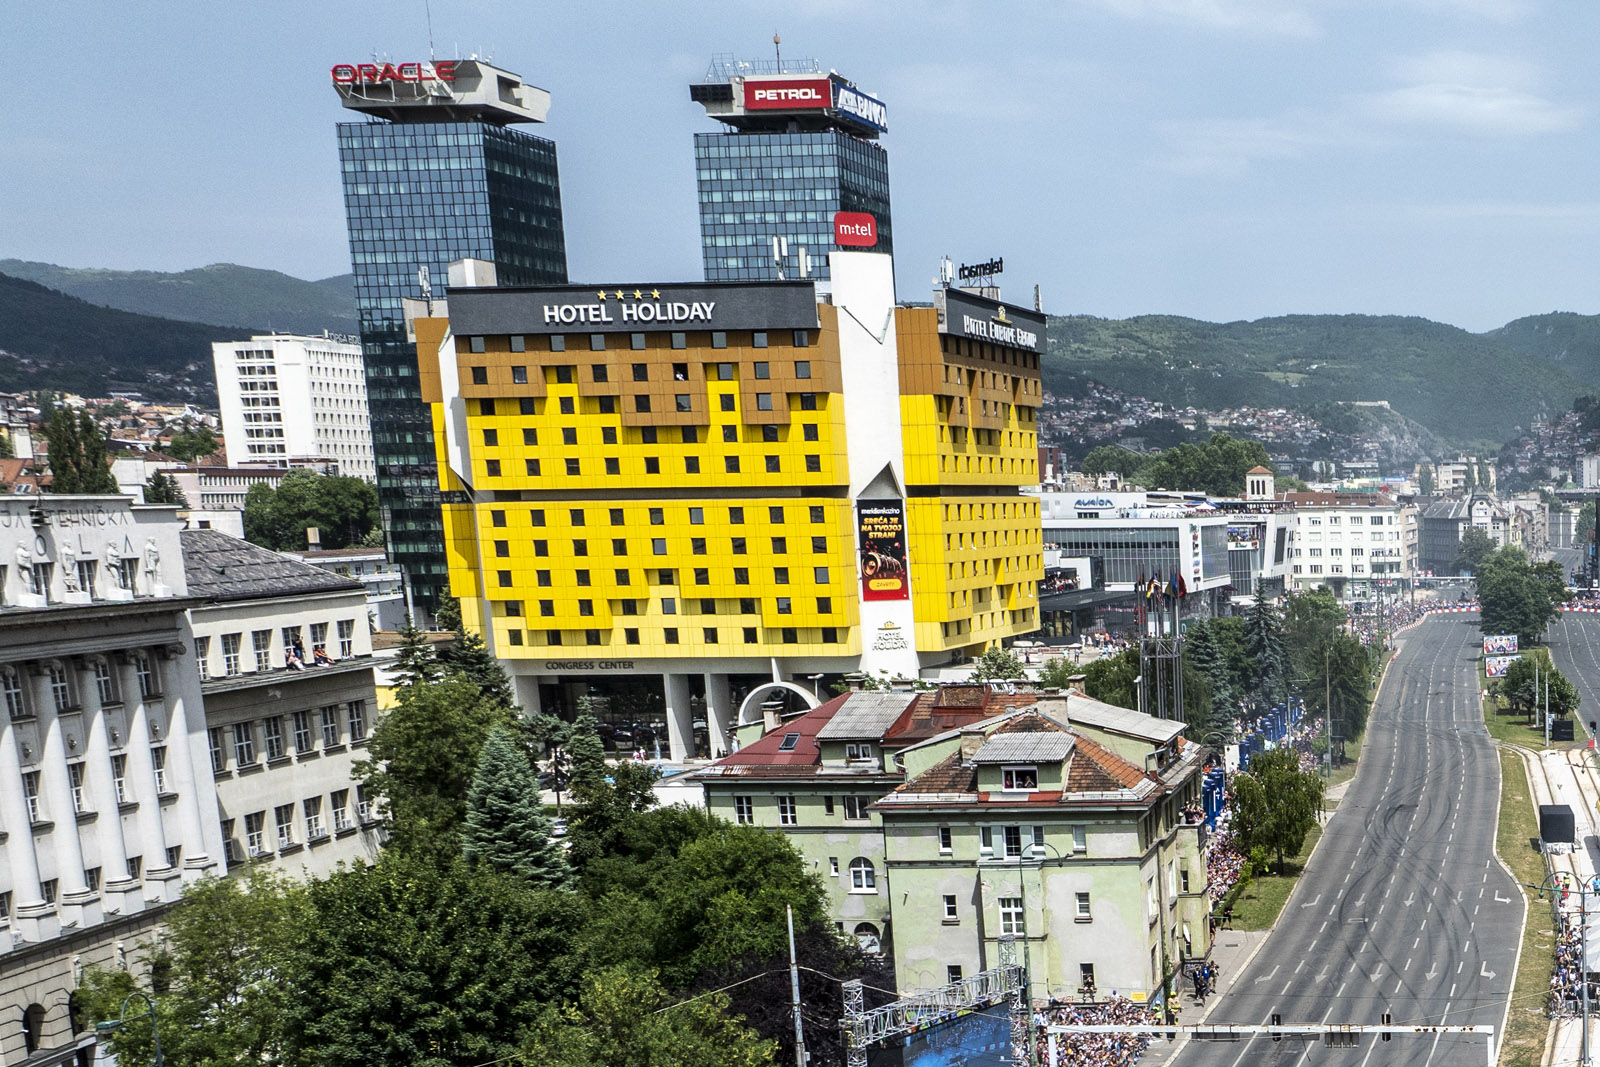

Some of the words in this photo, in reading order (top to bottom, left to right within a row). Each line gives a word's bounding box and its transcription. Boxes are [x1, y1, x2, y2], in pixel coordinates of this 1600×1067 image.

[331, 62, 456, 82] ORACLE
[754, 88, 822, 100] PETROL
[839, 222, 872, 236] m:tel
[543, 303, 613, 323] HOTEL
[621, 302, 716, 321] HOLIDAY
[545, 661, 594, 670] CONGRESS
[598, 660, 634, 670] CENTER
